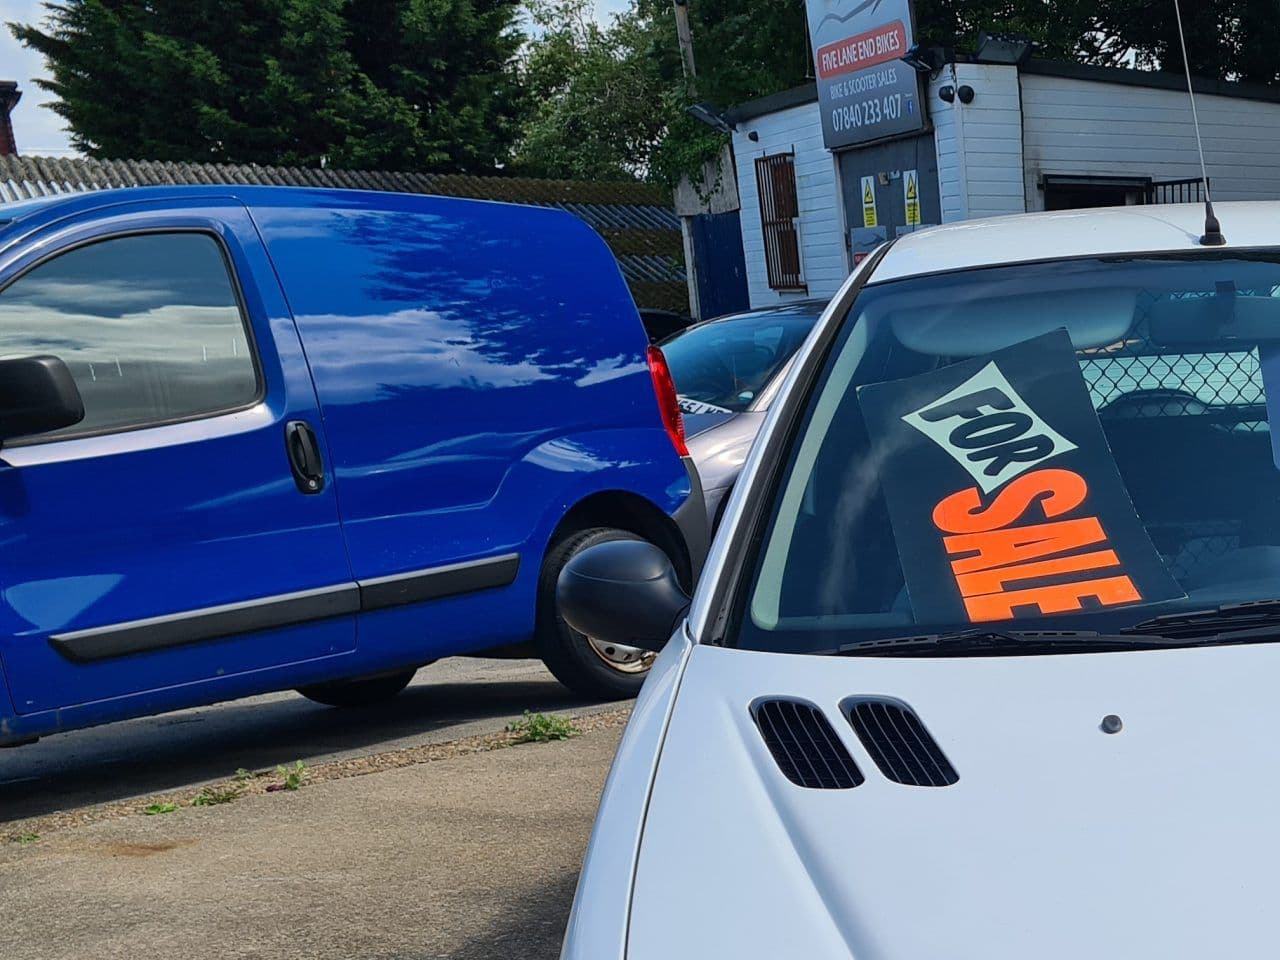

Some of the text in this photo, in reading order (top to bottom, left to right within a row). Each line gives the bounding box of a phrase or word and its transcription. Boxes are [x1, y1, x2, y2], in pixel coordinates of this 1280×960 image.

[822, 30, 900, 72] FIVE LANE END BIKES
[830, 82, 843, 99] BIKE
[848, 74, 877, 94] SCOOTER
[877, 68, 897, 88] SALES
[832, 93, 901, 132] 07840 233 407
[918, 386, 1055, 477] FOR
[932, 468, 1143, 623] SALE
